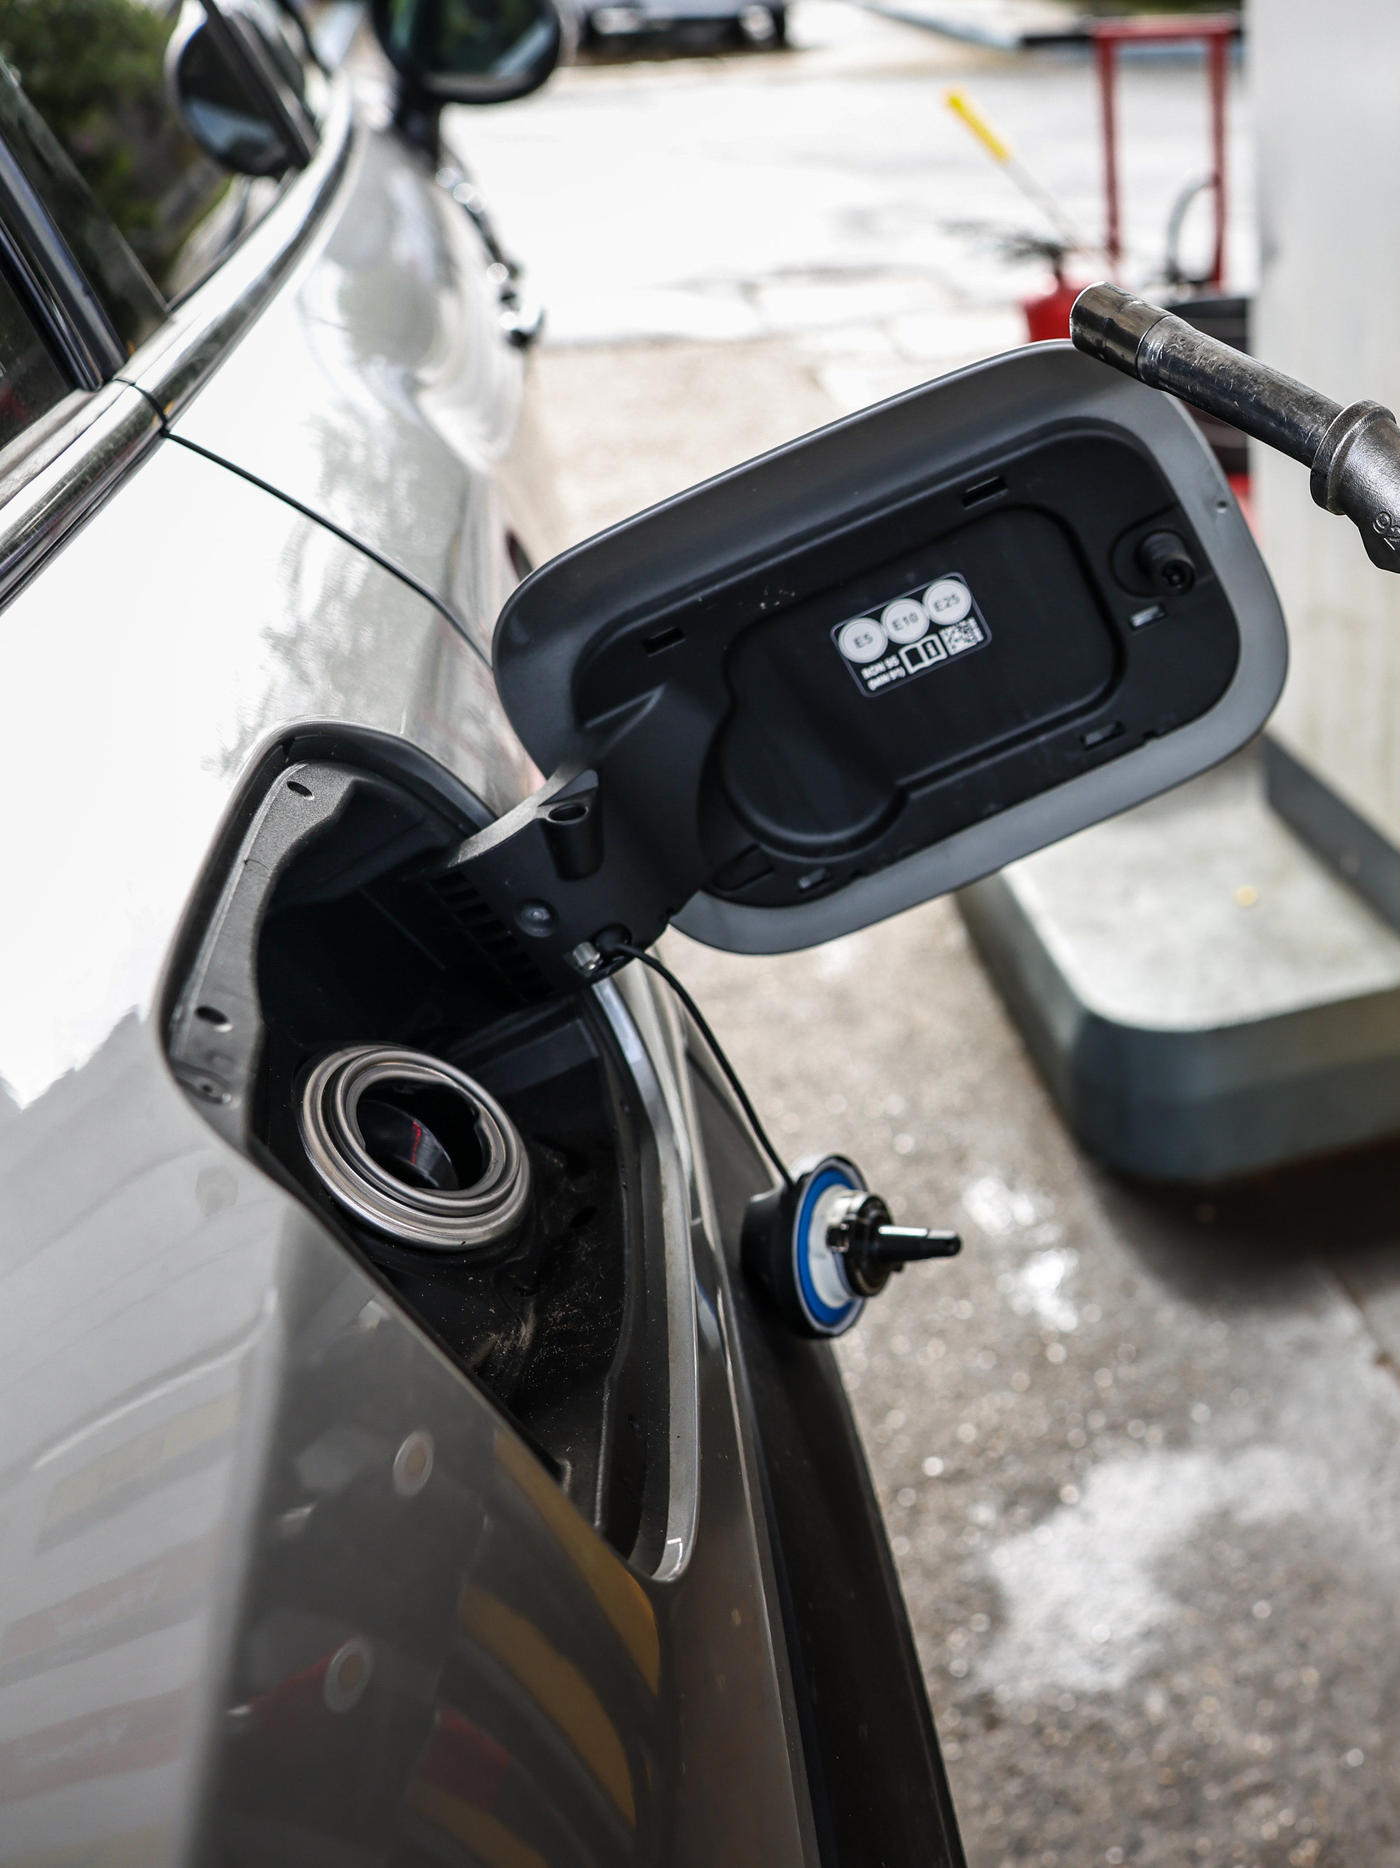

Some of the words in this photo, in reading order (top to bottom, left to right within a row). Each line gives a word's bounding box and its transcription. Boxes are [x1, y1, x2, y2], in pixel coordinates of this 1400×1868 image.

[853, 632, 873, 649] E5
[891, 612, 919, 631] E10
[934, 594, 961, 612] E25
